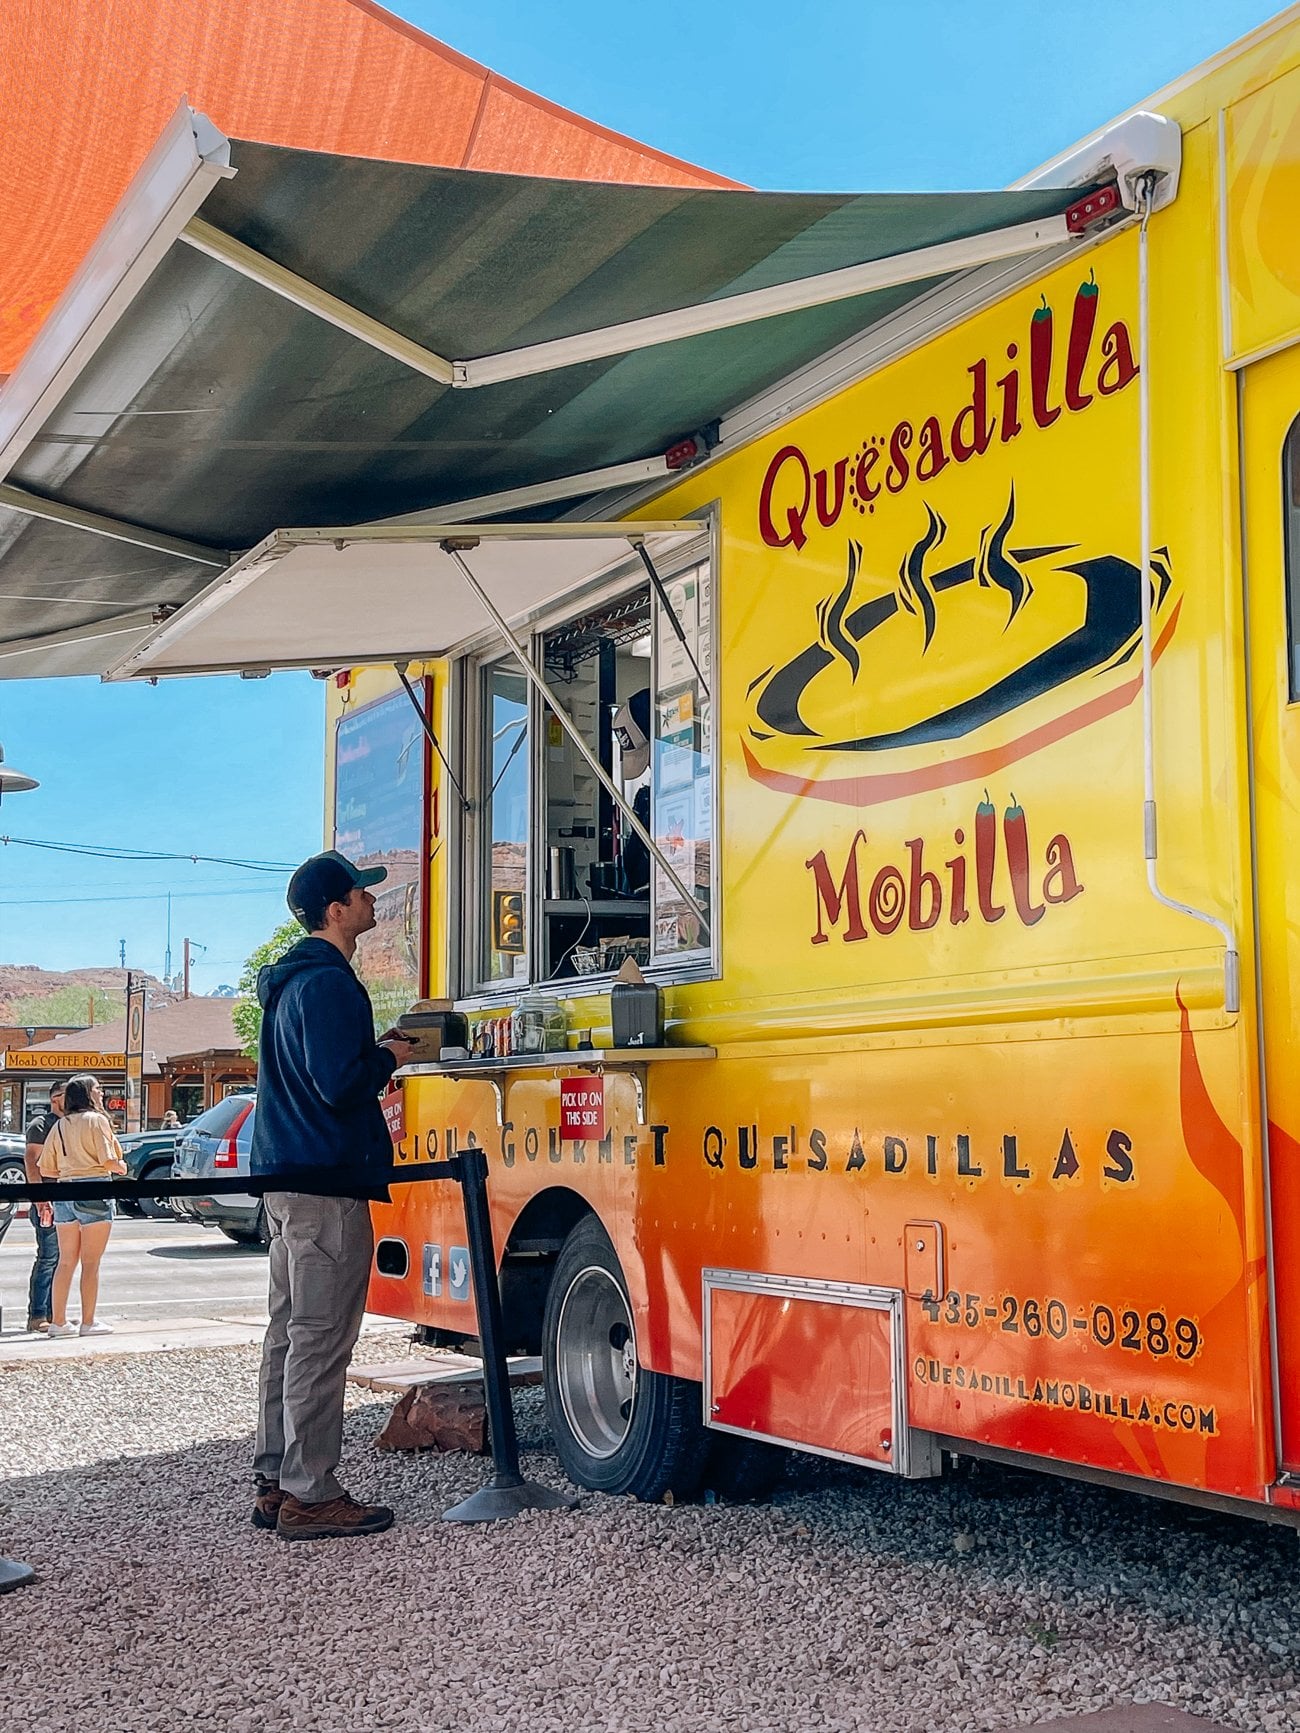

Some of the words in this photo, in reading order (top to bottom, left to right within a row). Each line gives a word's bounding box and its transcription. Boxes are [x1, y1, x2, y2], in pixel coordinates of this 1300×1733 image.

[758, 267, 1140, 551] Quesadilla
[805, 788, 1085, 945] Mobilla
[8, 1054, 38, 1067] Moab
[40, 1055, 80, 1067] COFFEE
[83, 1055, 126, 1067] ROASTE
[394, 1102, 403, 1116] ON
[561, 1092, 577, 1107] PICK
[578, 1092, 588, 1107] UP
[589, 1091, 602, 1107] ON
[391, 1118, 402, 1134] SIDE
[566, 1111, 581, 1126] THIS
[582, 1111, 598, 1126] SIDE
[501, 1121, 669, 1169] GOURMET
[921, 1288, 1202, 1360] 435-260-0289
[913, 1357, 1216, 1434] QUESADILLAMOBILLA.COM
